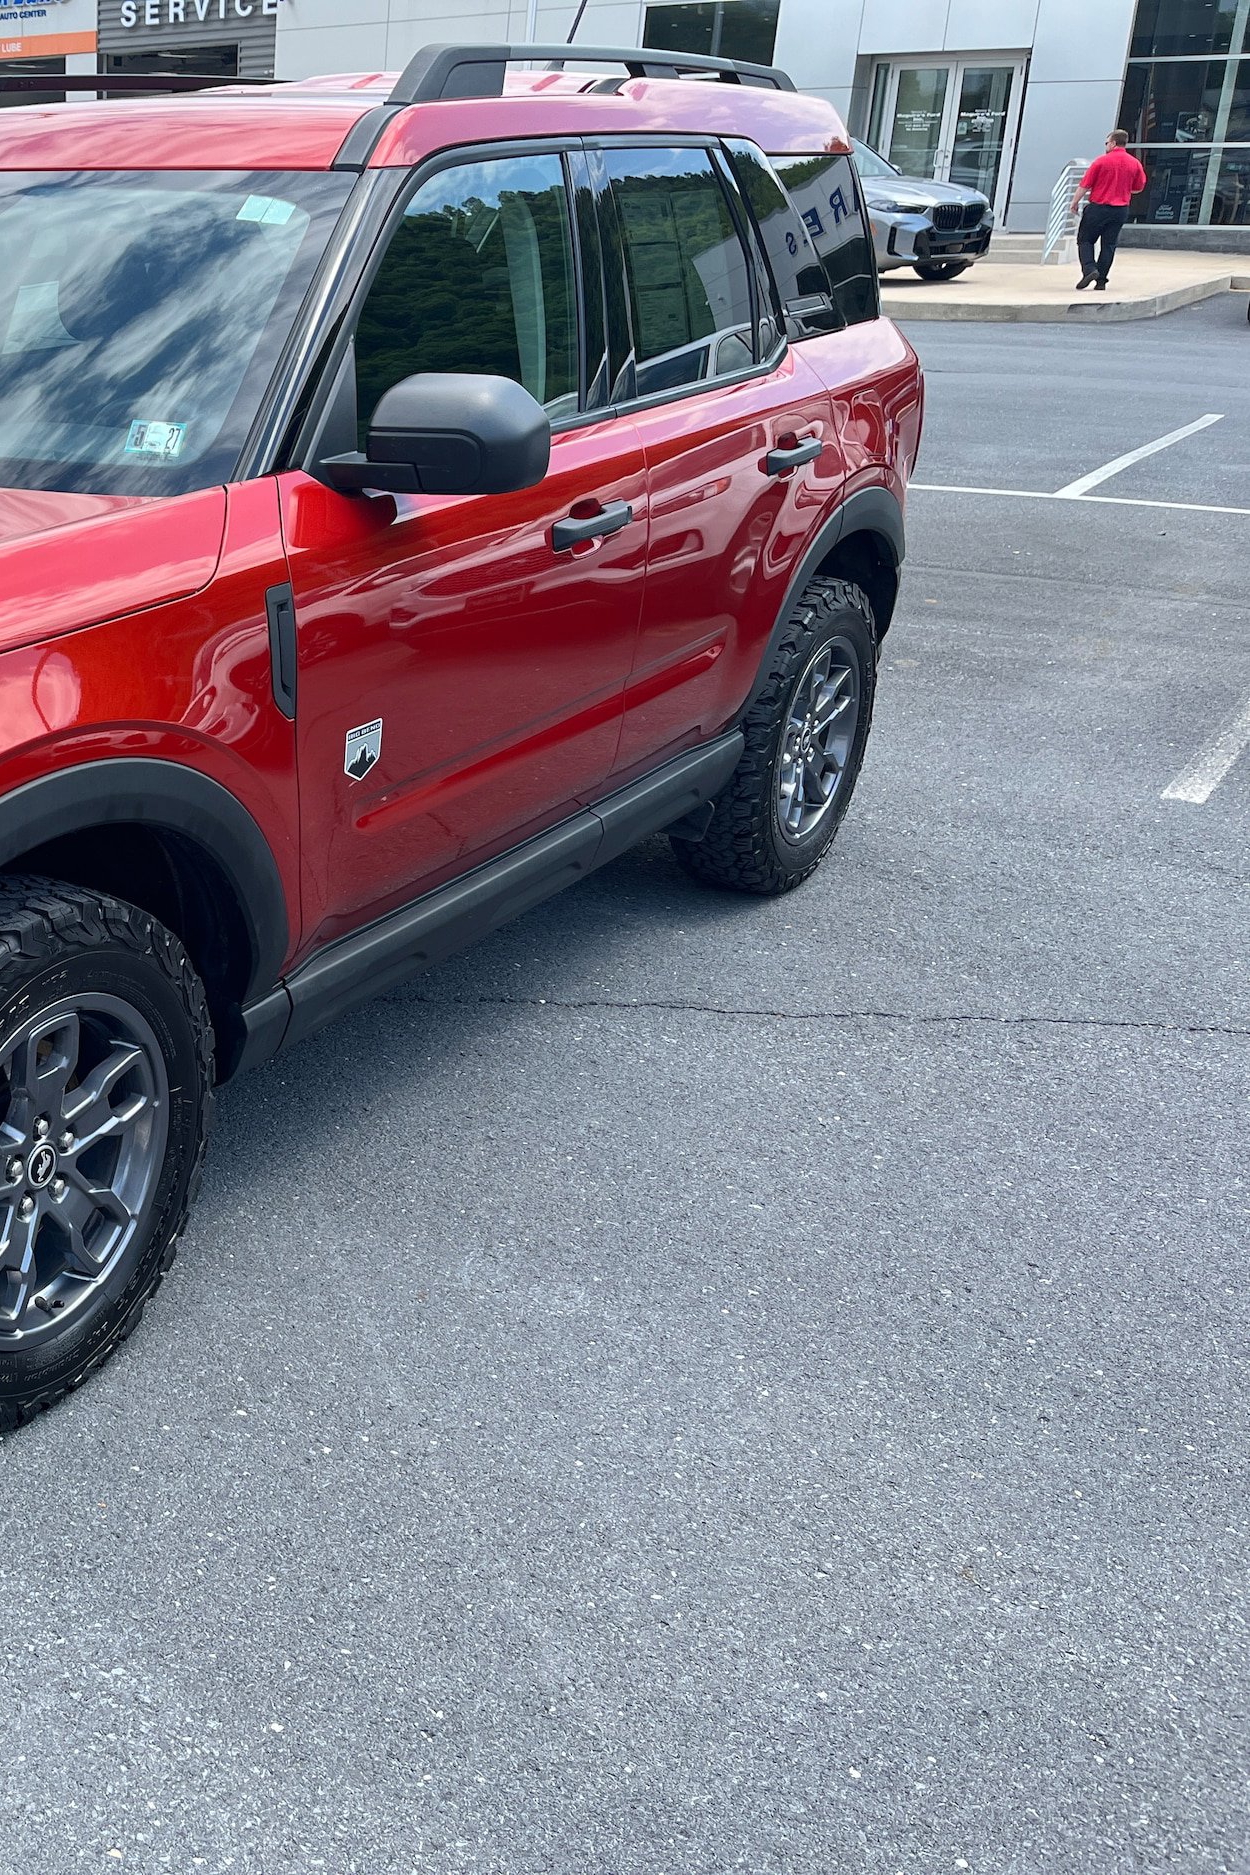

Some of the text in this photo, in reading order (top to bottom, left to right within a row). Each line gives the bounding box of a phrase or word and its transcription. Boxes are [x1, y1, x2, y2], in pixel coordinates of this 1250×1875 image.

[0, 11, 18, 20] AUTO
[19, 9, 47, 19] CENTER
[1, 42, 22, 53] LUBE
[165, 428, 181, 449] 27
